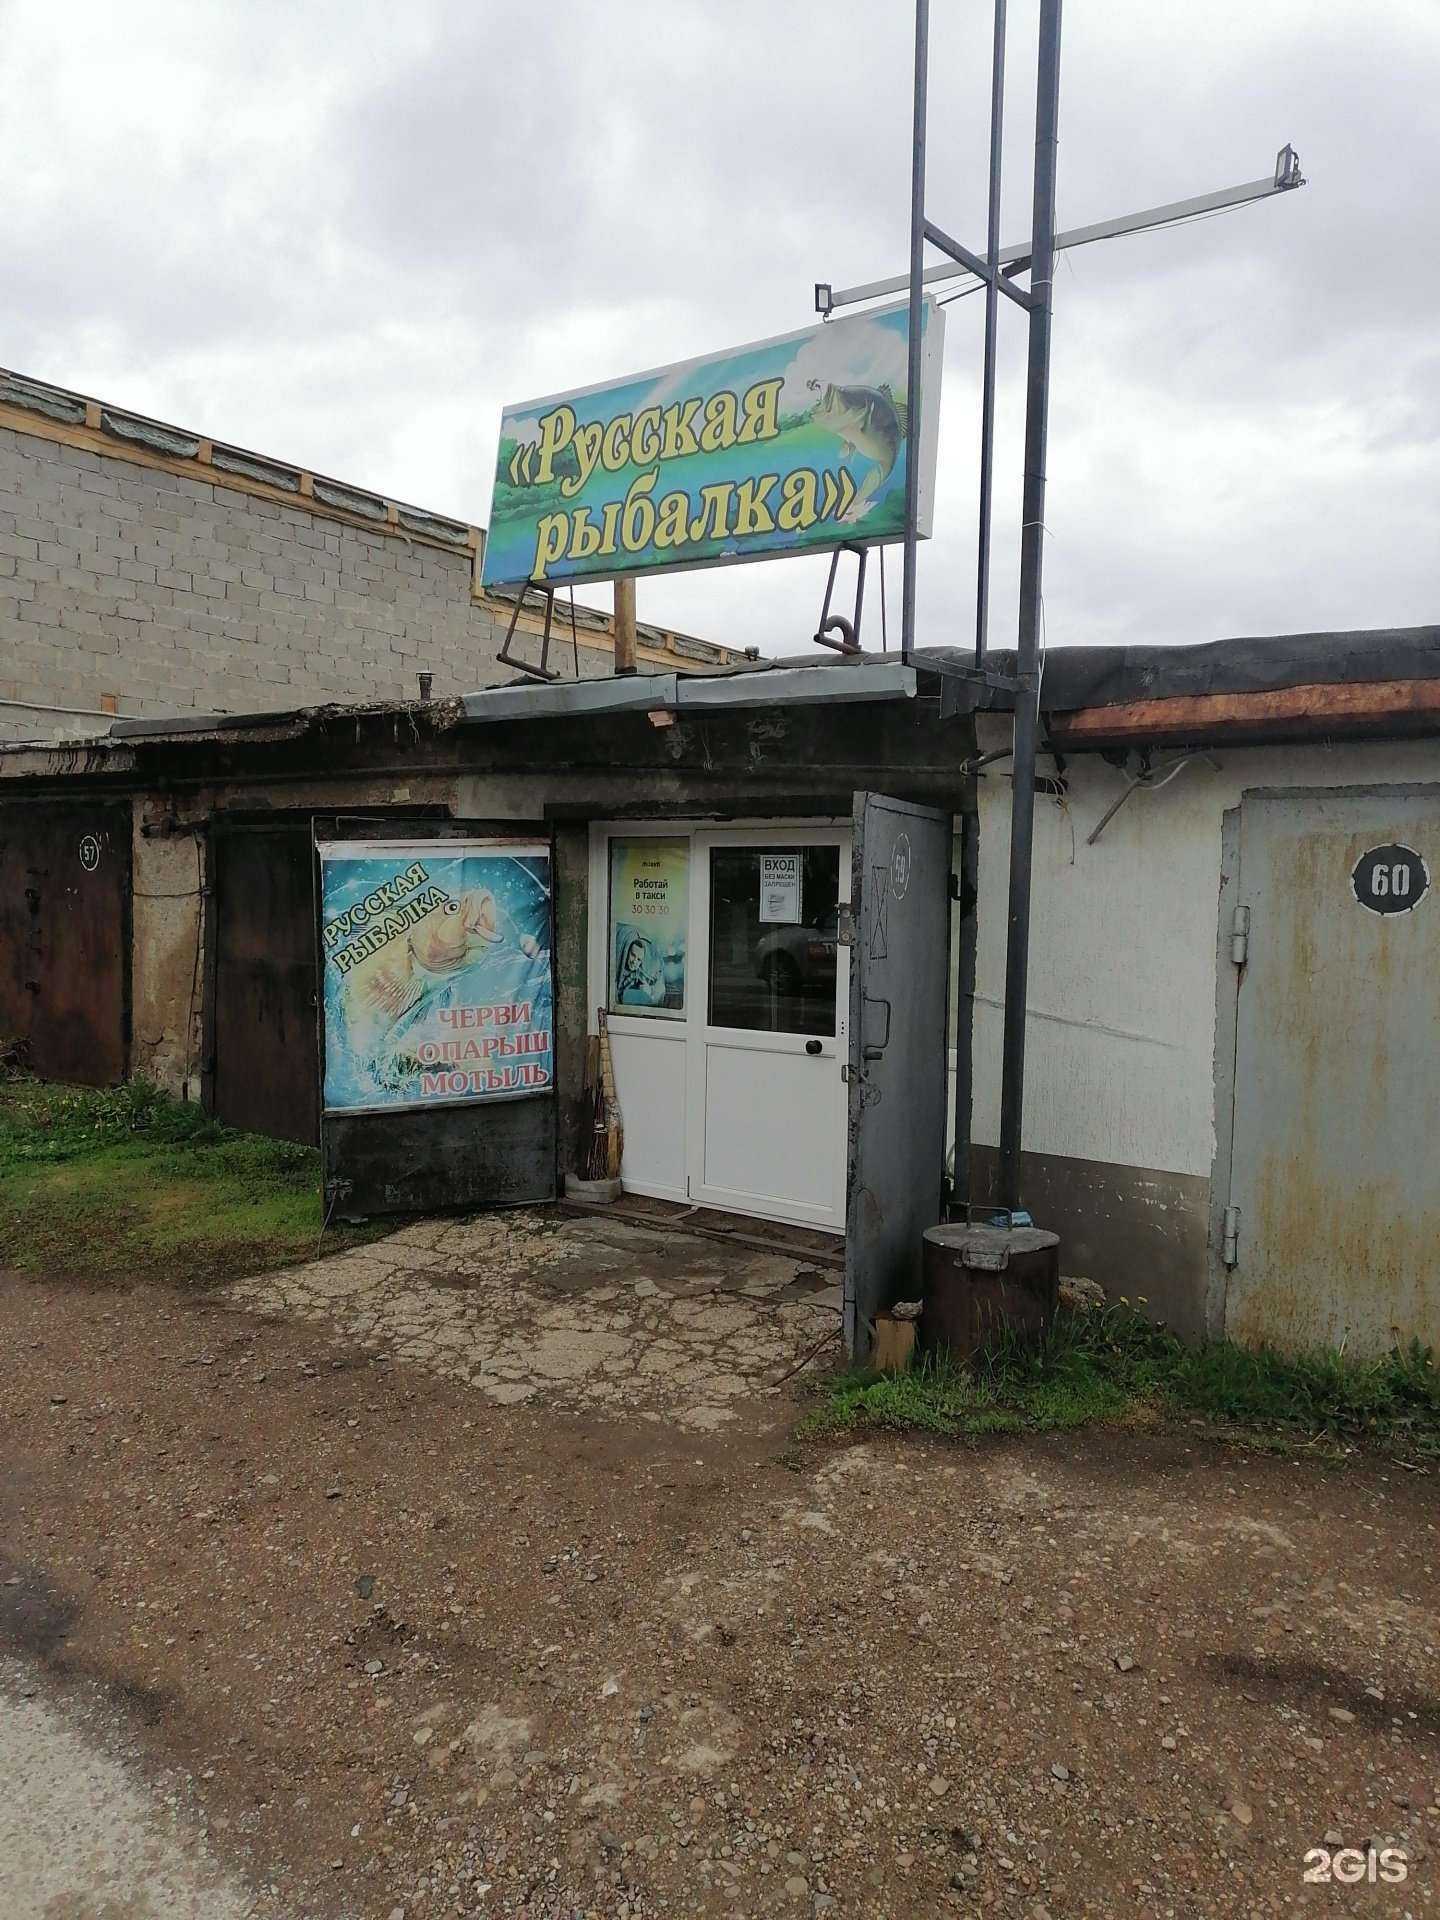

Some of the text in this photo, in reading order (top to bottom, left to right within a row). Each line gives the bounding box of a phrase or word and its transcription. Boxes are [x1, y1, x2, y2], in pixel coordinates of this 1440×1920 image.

[508, 377, 785, 497] «Русская
[530, 466, 857, 581] рыбалка»
[84, 846, 95, 861] 57
[764, 859, 795, 872] ВХОД
[633, 878, 669, 889] Работай
[642, 891, 666, 900] такси
[1371, 864, 1410, 896] 60
[323, 861, 430, 948] РУССКАЯ
[632, 904, 643, 914] 30
[644, 904, 656, 914] 30
[332, 886, 449, 974] РЫБАЛКА
[438, 1003, 531, 1029] ЧЕРВИ
[418, 1032, 549, 1064] ОПАРЫШ
[421, 1064, 548, 1095] МОТЫЛЬ
